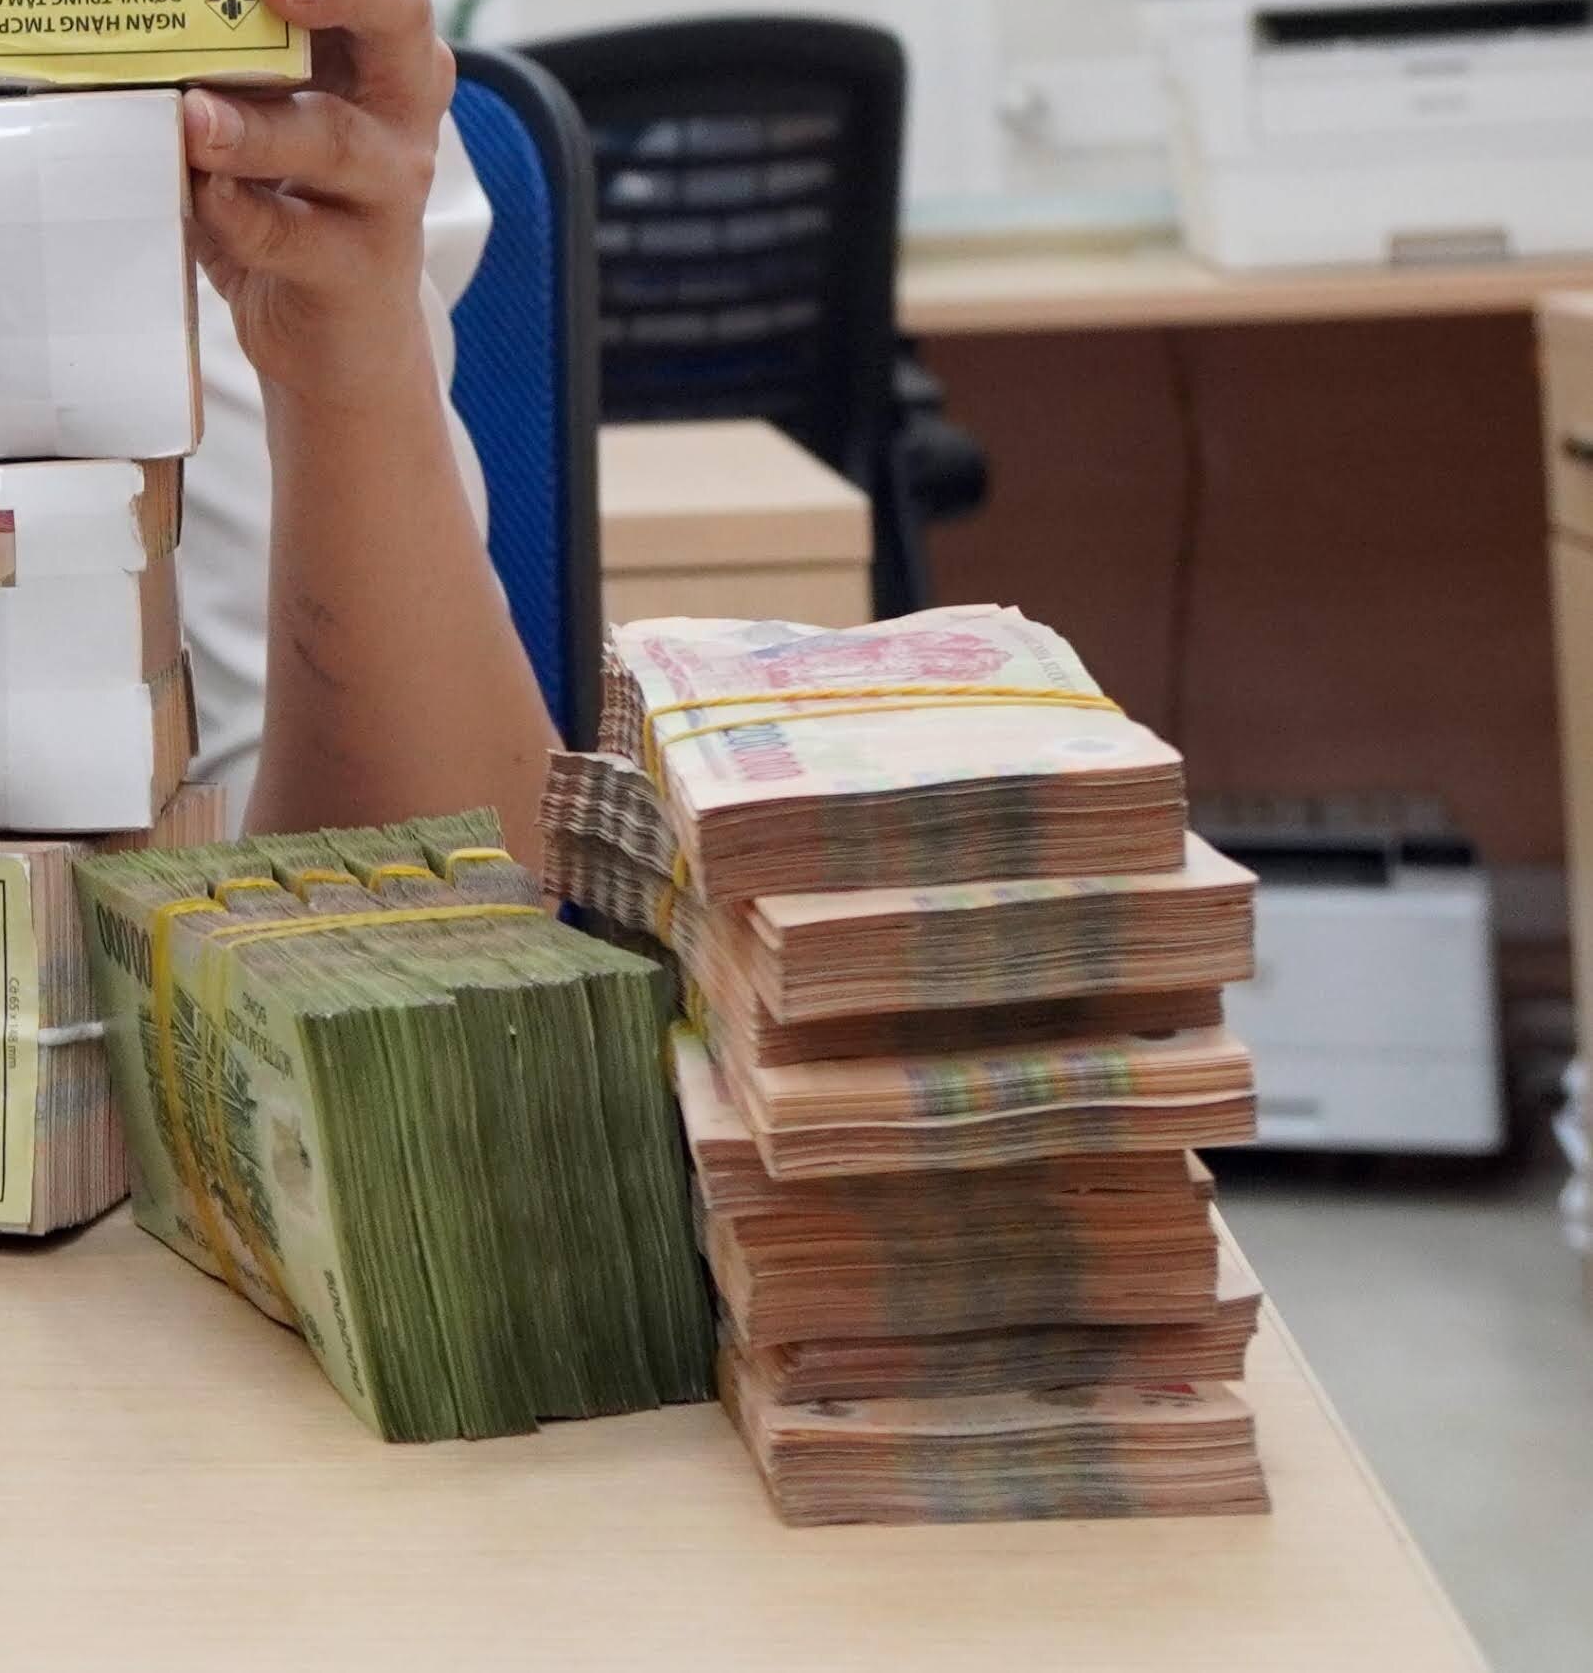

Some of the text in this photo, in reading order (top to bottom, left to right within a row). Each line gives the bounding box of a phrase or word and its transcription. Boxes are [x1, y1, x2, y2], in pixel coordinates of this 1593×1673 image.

[60, 14, 120, 36] HÀNG
[126, 12, 186, 33] NGÂN
[9, 996, 19, 1013] 65
